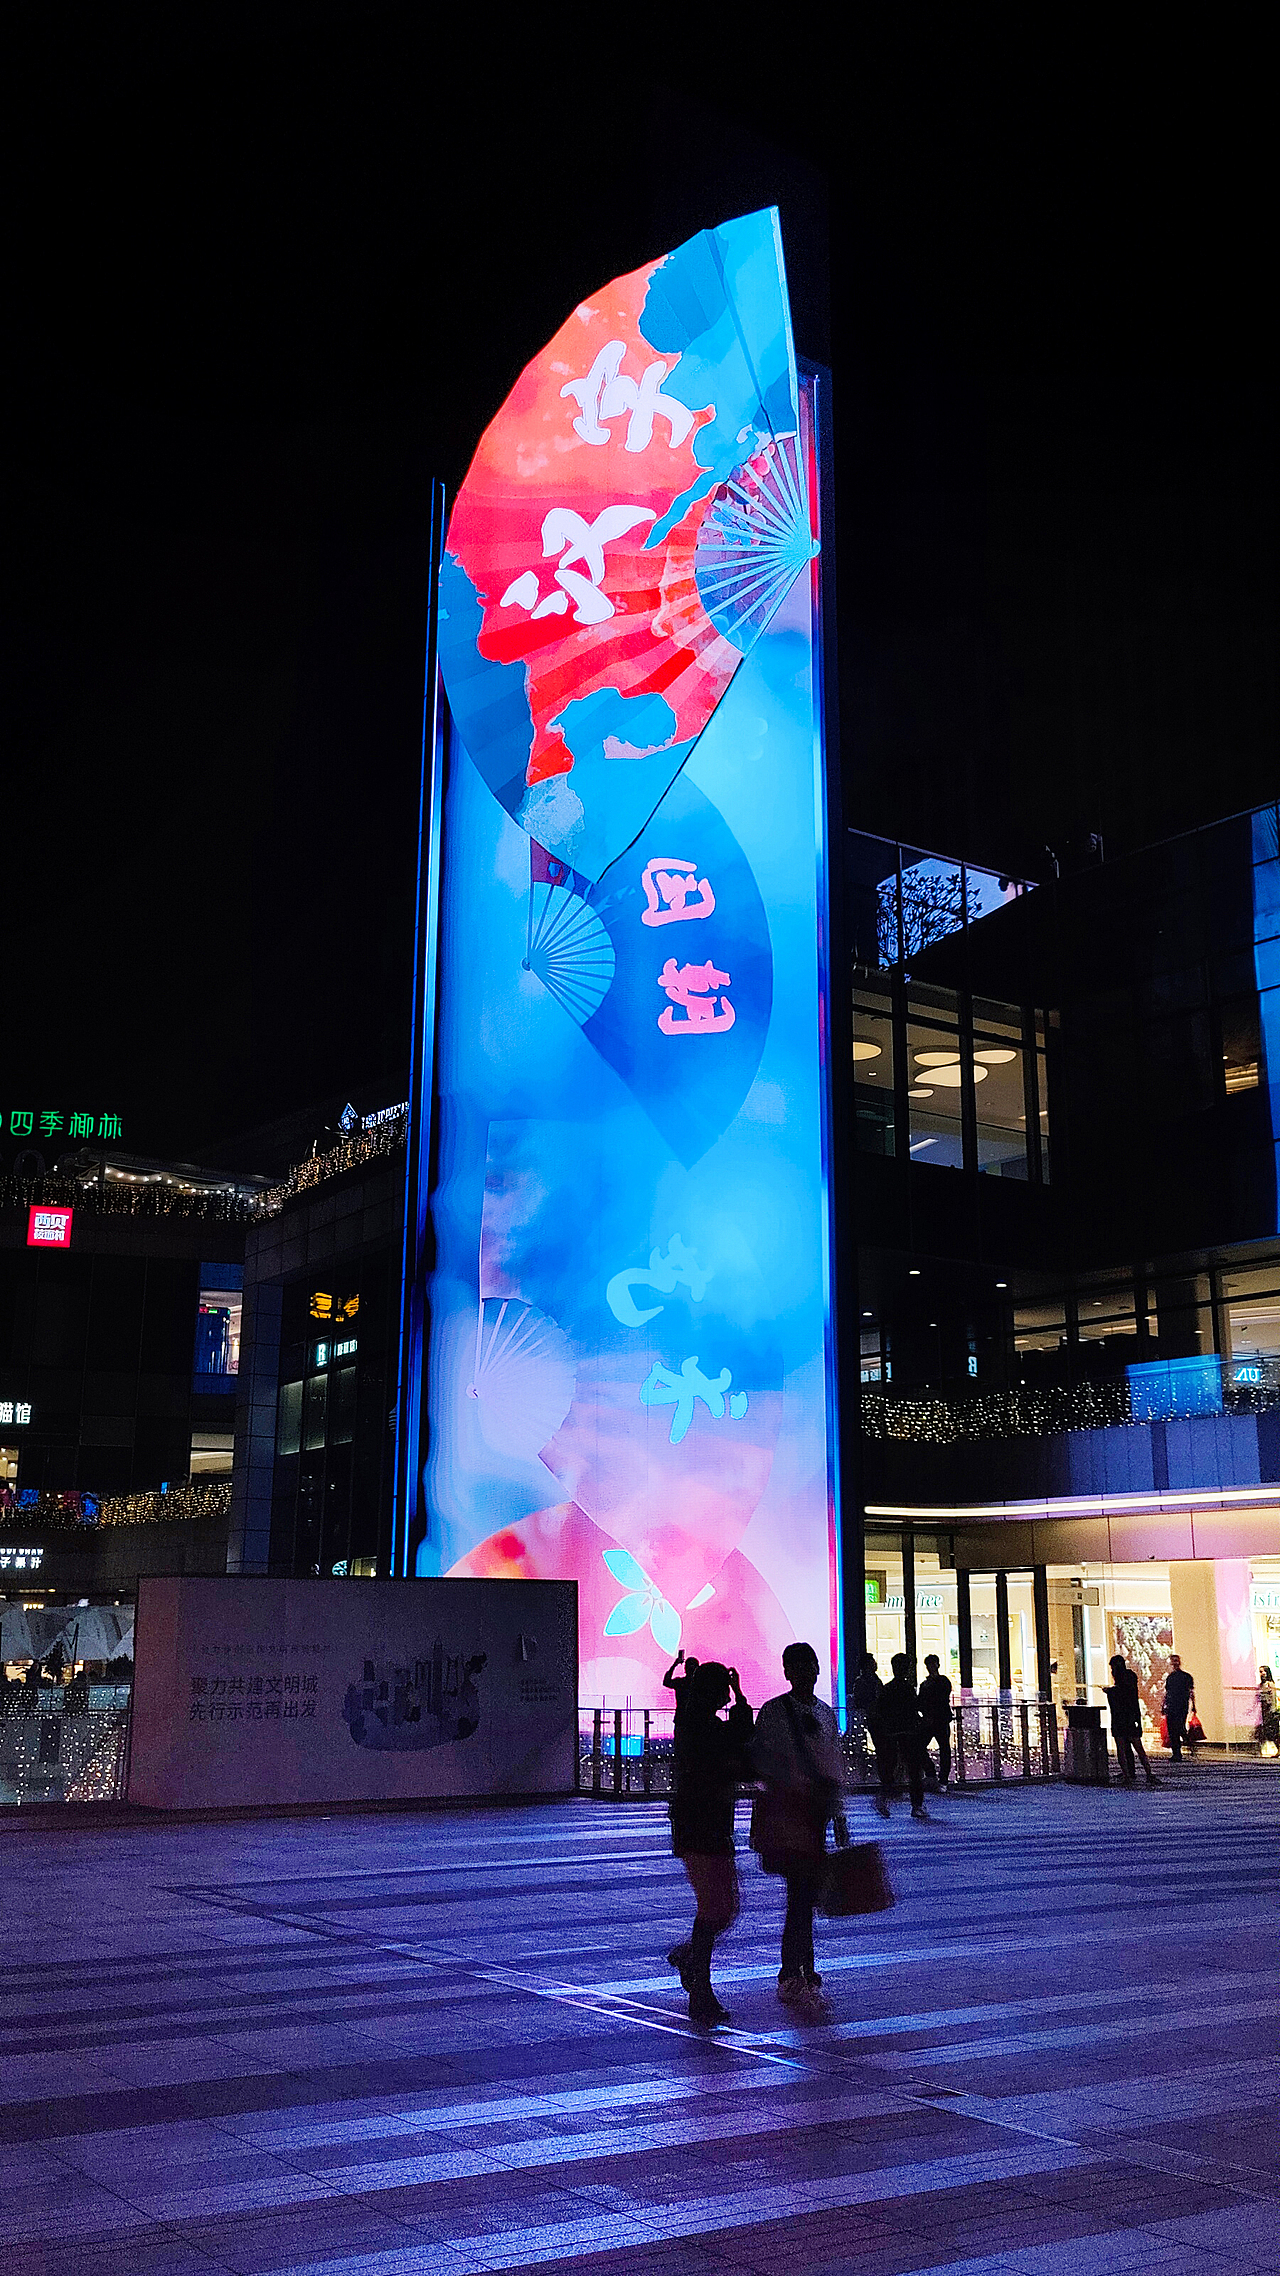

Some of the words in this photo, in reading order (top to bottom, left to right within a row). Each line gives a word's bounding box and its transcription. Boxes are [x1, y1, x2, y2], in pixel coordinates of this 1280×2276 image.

[10, 1110, 123, 1140] 四季椰林
[190, 1675, 319, 1696] 聚力共建文明城
[189, 1699, 318, 1721] 先行示范再出发
